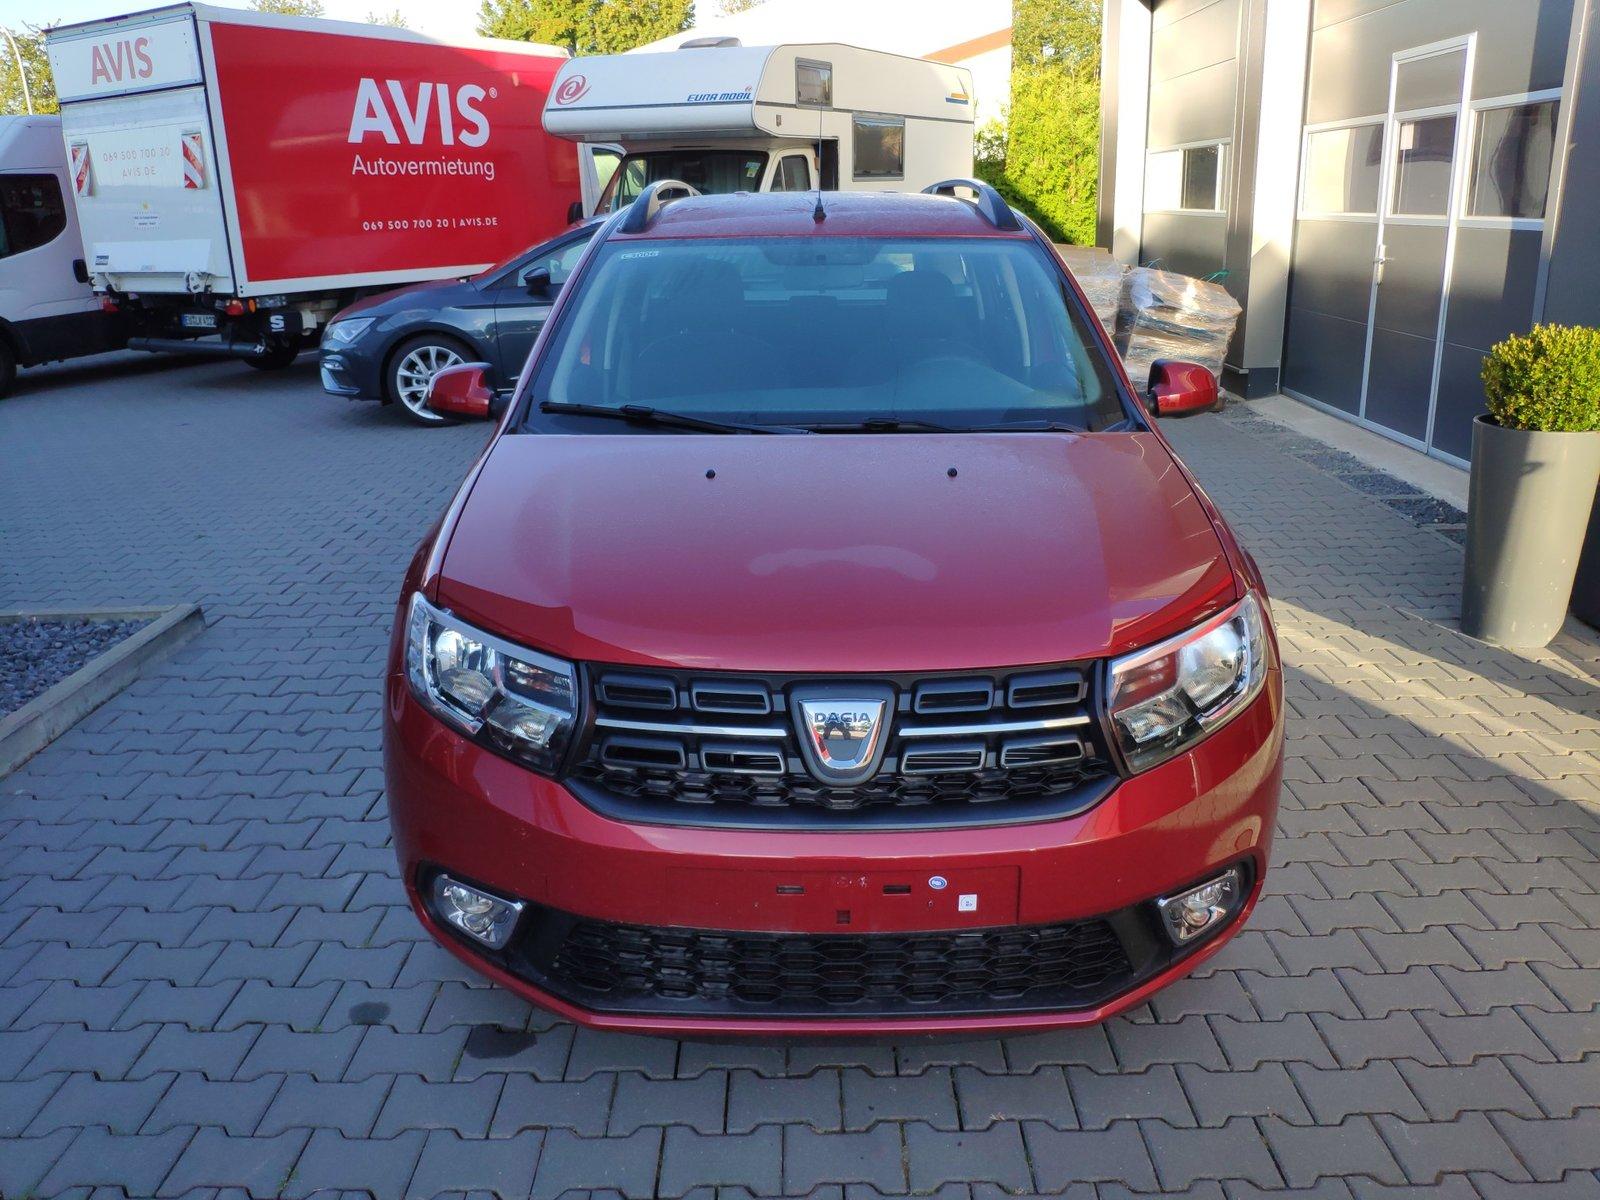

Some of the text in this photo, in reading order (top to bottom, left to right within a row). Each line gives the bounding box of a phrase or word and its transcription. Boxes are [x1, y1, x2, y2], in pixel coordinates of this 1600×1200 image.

[92, 37, 153, 85] AVIS
[351, 154, 495, 181] Autovermietung
[363, 221, 383, 231] 069
[387, 220, 409, 230] 500
[412, 219, 433, 229] 700
[436, 218, 449, 228] 20
[460, 217, 498, 227] AVIS.DE
